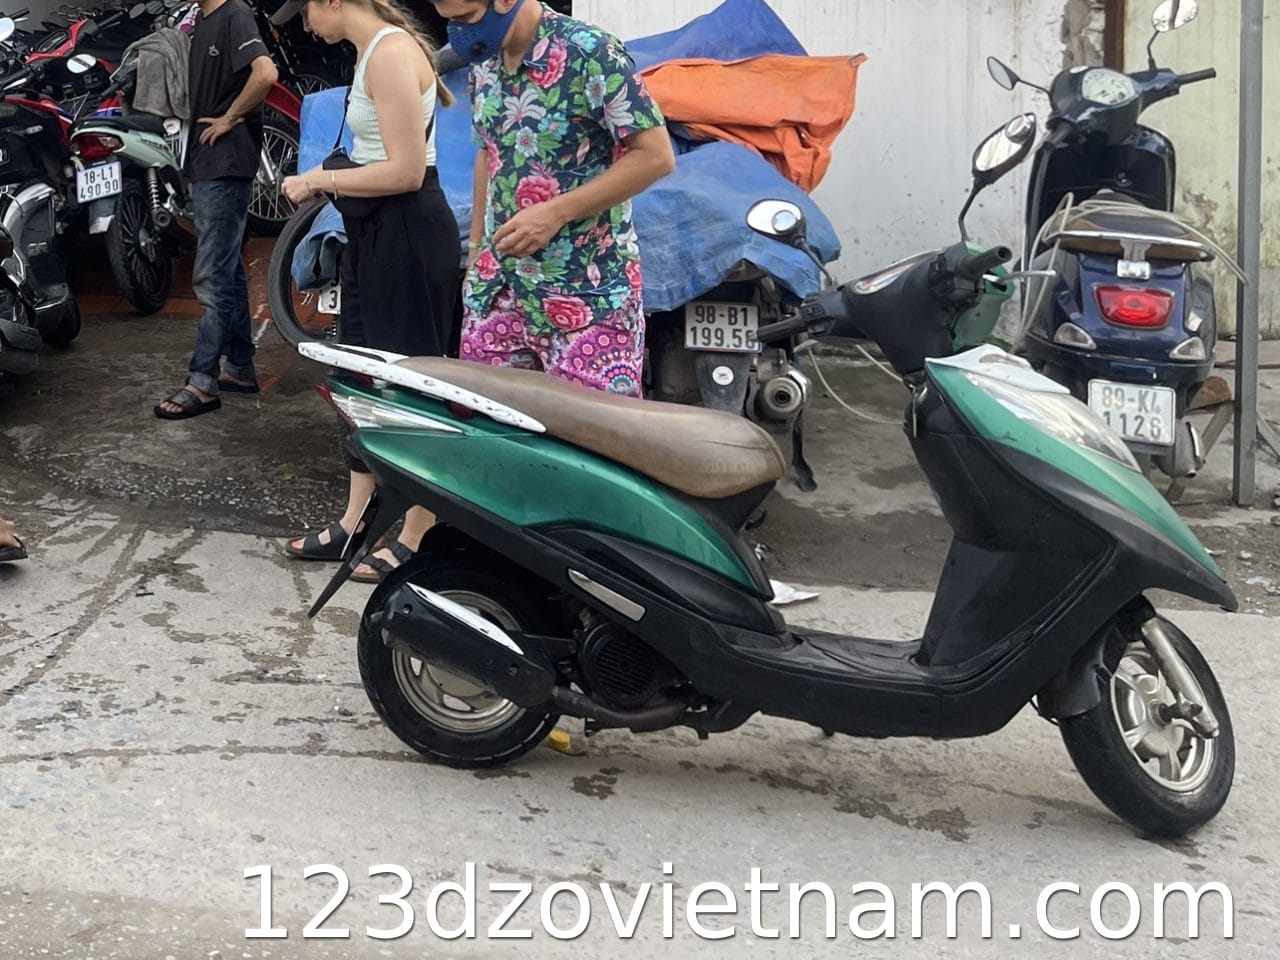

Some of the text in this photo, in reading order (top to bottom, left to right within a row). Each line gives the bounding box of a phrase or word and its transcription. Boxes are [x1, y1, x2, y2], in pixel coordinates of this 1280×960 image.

[84, 166, 114, 185] 18-L1
[695, 304, 749, 327] 98-B1
[1103, 410, 1162, 440] 1126
